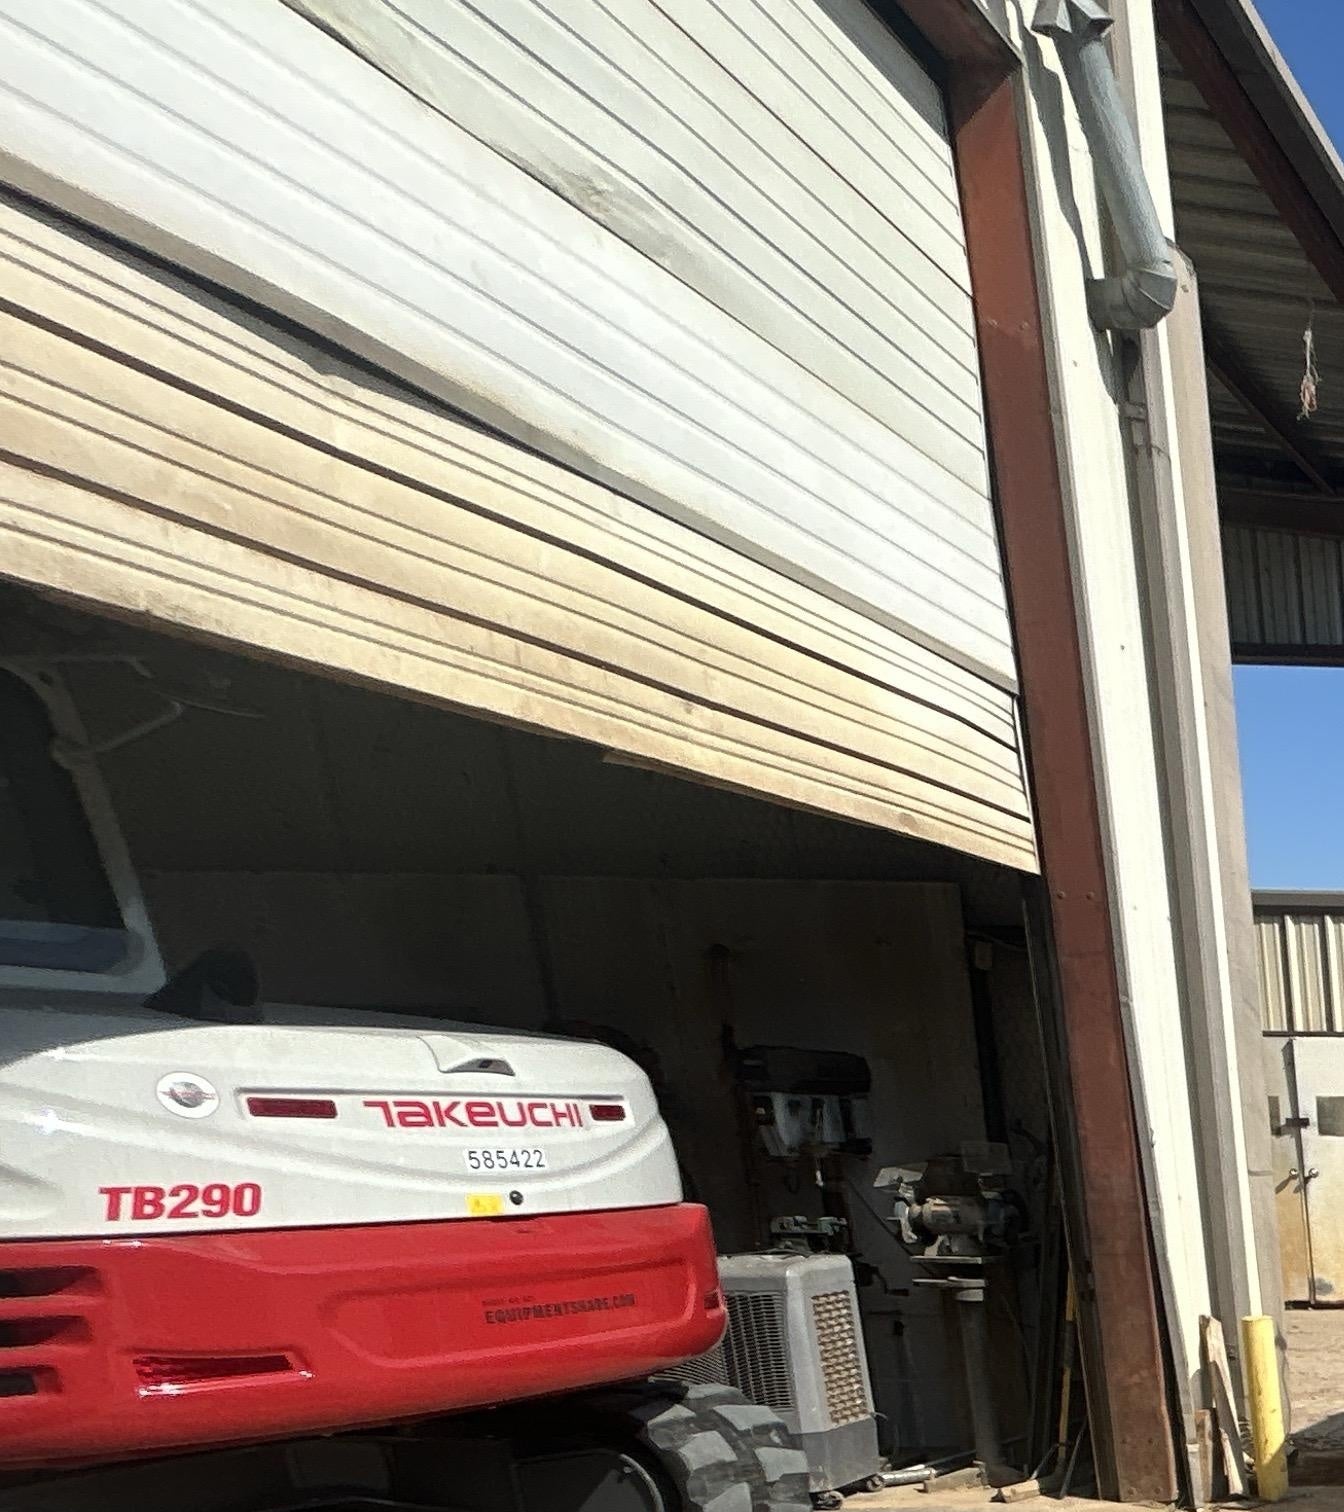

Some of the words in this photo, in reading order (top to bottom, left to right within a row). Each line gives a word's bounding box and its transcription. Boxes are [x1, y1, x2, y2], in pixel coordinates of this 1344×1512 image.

[363, 1100, 584, 1128] TAKEUCHI
[468, 1149, 546, 1169] 585422
[98, 1182, 262, 1221] TB290
